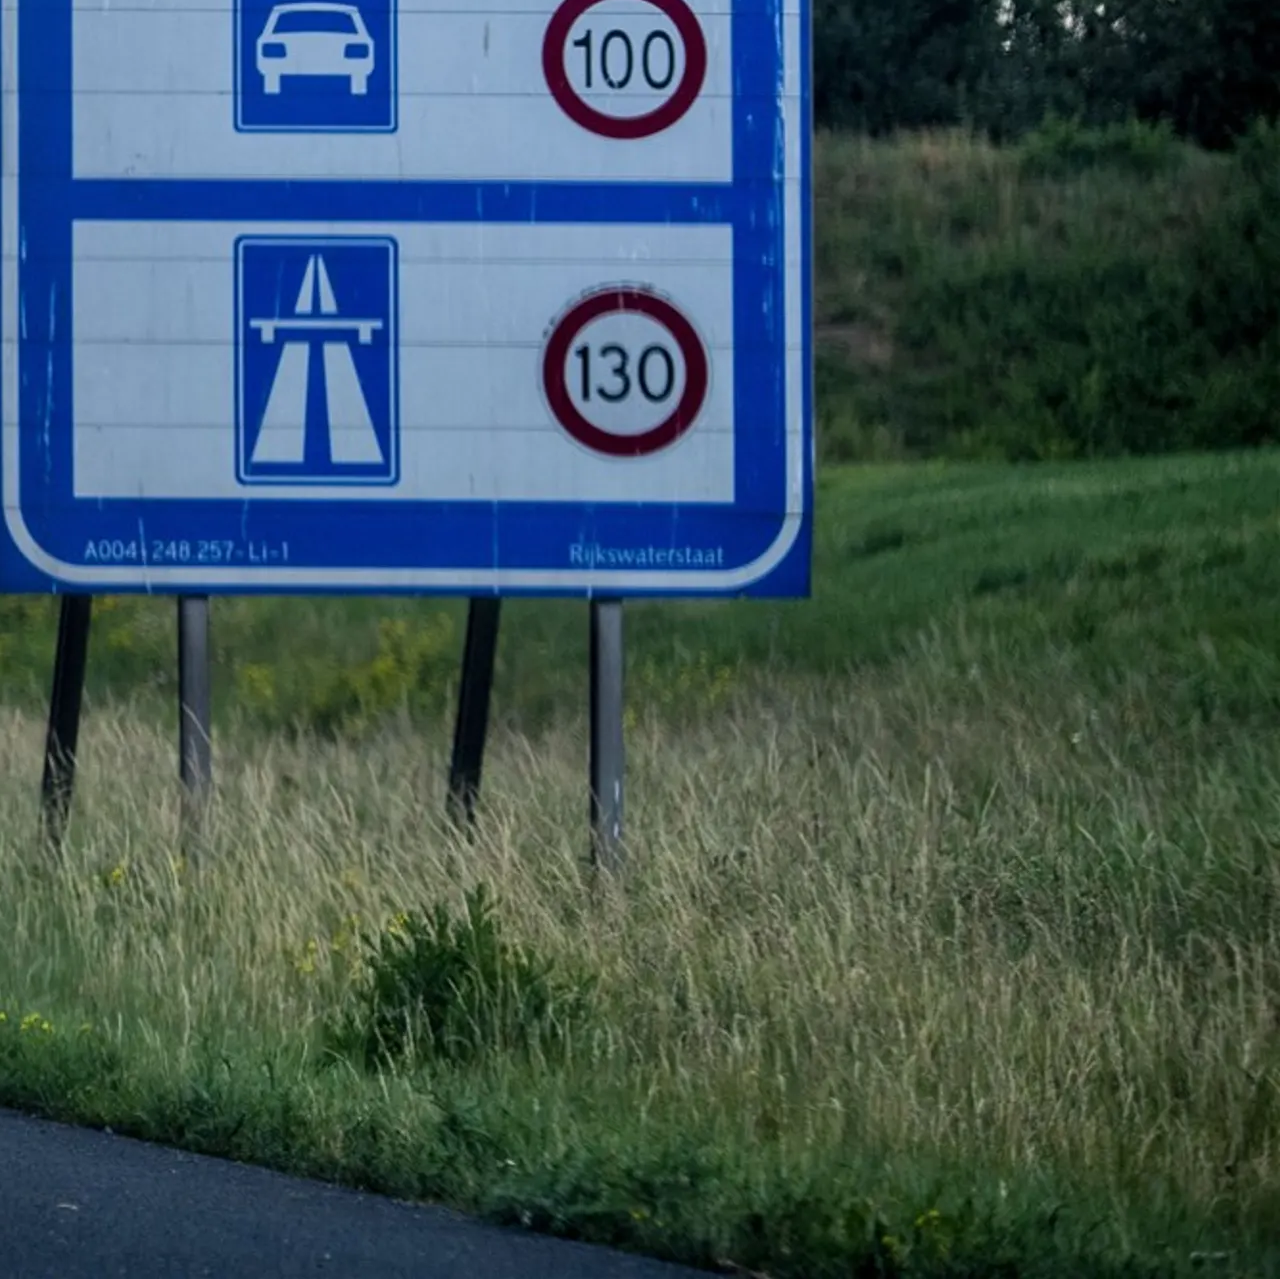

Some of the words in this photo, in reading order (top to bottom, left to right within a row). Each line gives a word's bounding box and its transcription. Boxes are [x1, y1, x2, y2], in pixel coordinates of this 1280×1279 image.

[573, 29, 675, 89] 100
[575, 344, 675, 403] 130
[569, 543, 724, 568] Rijkswaterstaat
